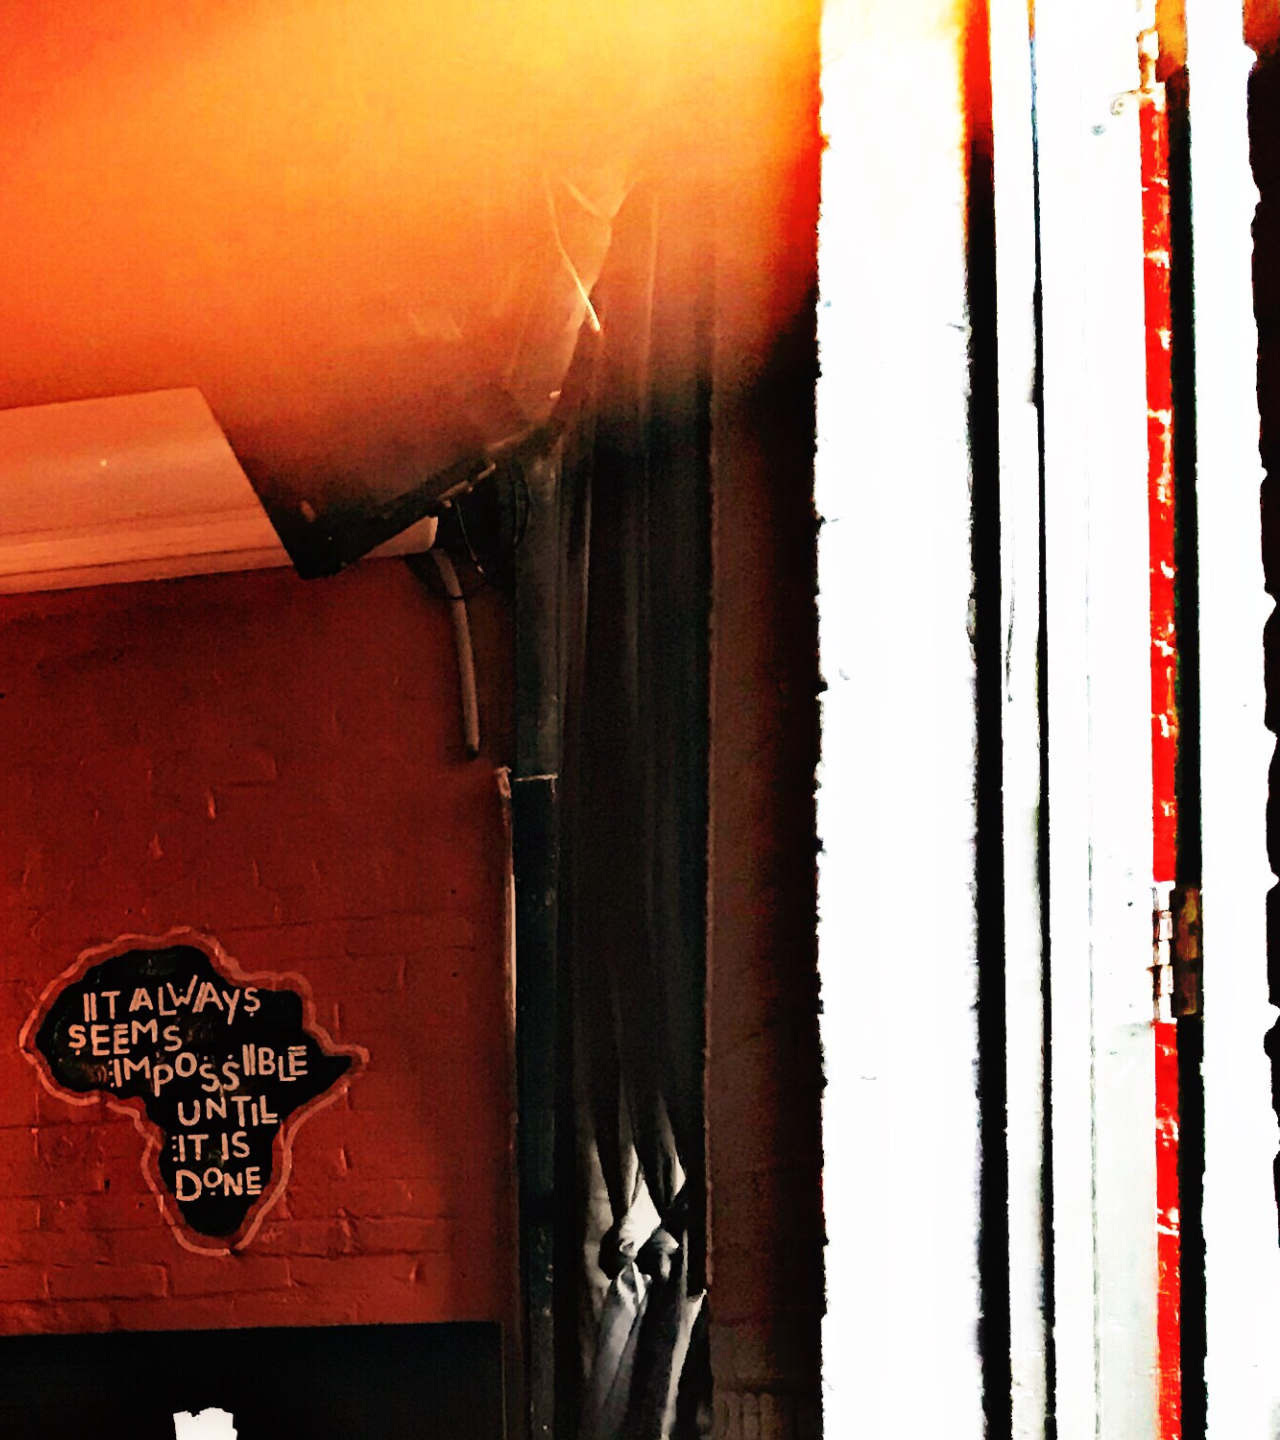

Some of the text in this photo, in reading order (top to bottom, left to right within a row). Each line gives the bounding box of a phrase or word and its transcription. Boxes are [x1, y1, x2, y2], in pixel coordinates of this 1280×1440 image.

[129, 974, 262, 1025] ALWAYS
[68, 1019, 183, 1056] SEEMS
[108, 1044, 309, 1098] IMPOSSIBLE
[177, 1095, 278, 1127] UNTIL
[172, 1131, 250, 1162] IT IS
[175, 1166, 262, 1202] DONE
